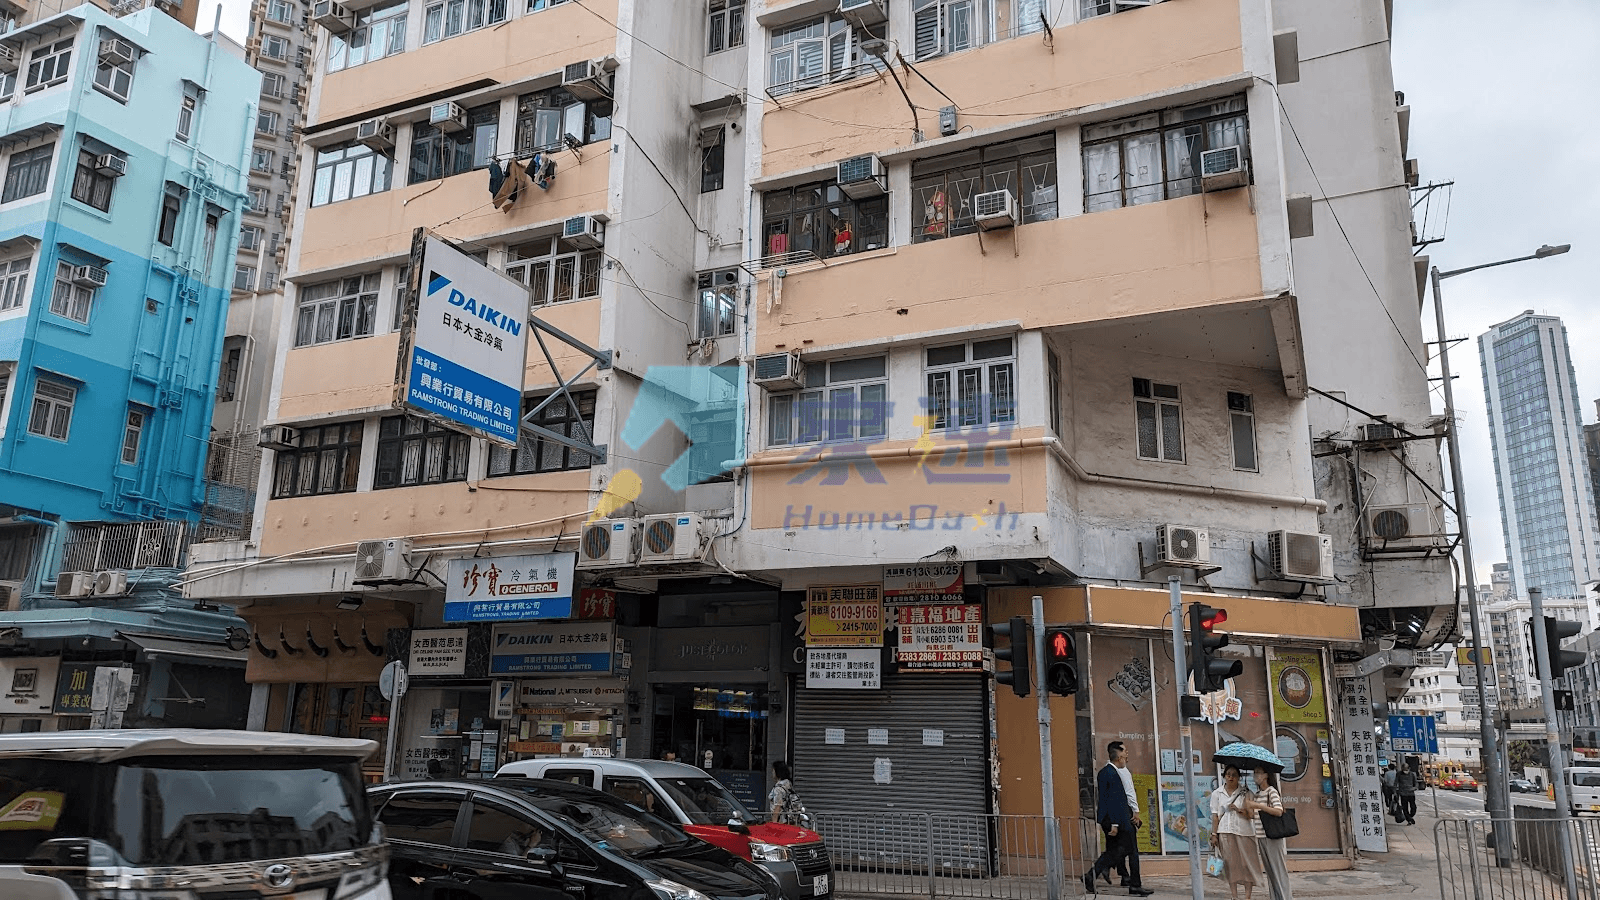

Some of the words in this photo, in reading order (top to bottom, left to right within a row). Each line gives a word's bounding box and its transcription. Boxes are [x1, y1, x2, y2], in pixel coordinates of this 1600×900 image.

[448, 288, 522, 337] DAIKIN
[442, 312, 503, 351] 日本大金冷氣
[411, 388, 458, 413] RAMSTRONG
[459, 406, 489, 425] TRADING
[490, 417, 515, 434] LIMITED
[463, 562, 503, 597] 珍寶
[510, 567, 558, 582] 冷氣機
[583, 592, 614, 618] 珍寶
[831, 605, 878, 619] 8109-9166
[910, 605, 980, 623] 嘉福地產
[842, 622, 878, 632] 2415-7000
[508, 634, 553, 645] DAIKIN
[559, 633, 608, 643] 日本大金冷氣
[930, 635, 946, 643] 6903
[948, 635, 964, 643] 5314
[899, 653, 917, 661] 2383
[942, 652, 961, 660] 2383
[962, 652, 982, 660] 6088
[69, 669, 88, 691] 加
[528, 687, 556, 695] National
[1119, 731, 1144, 741] Dumpling
